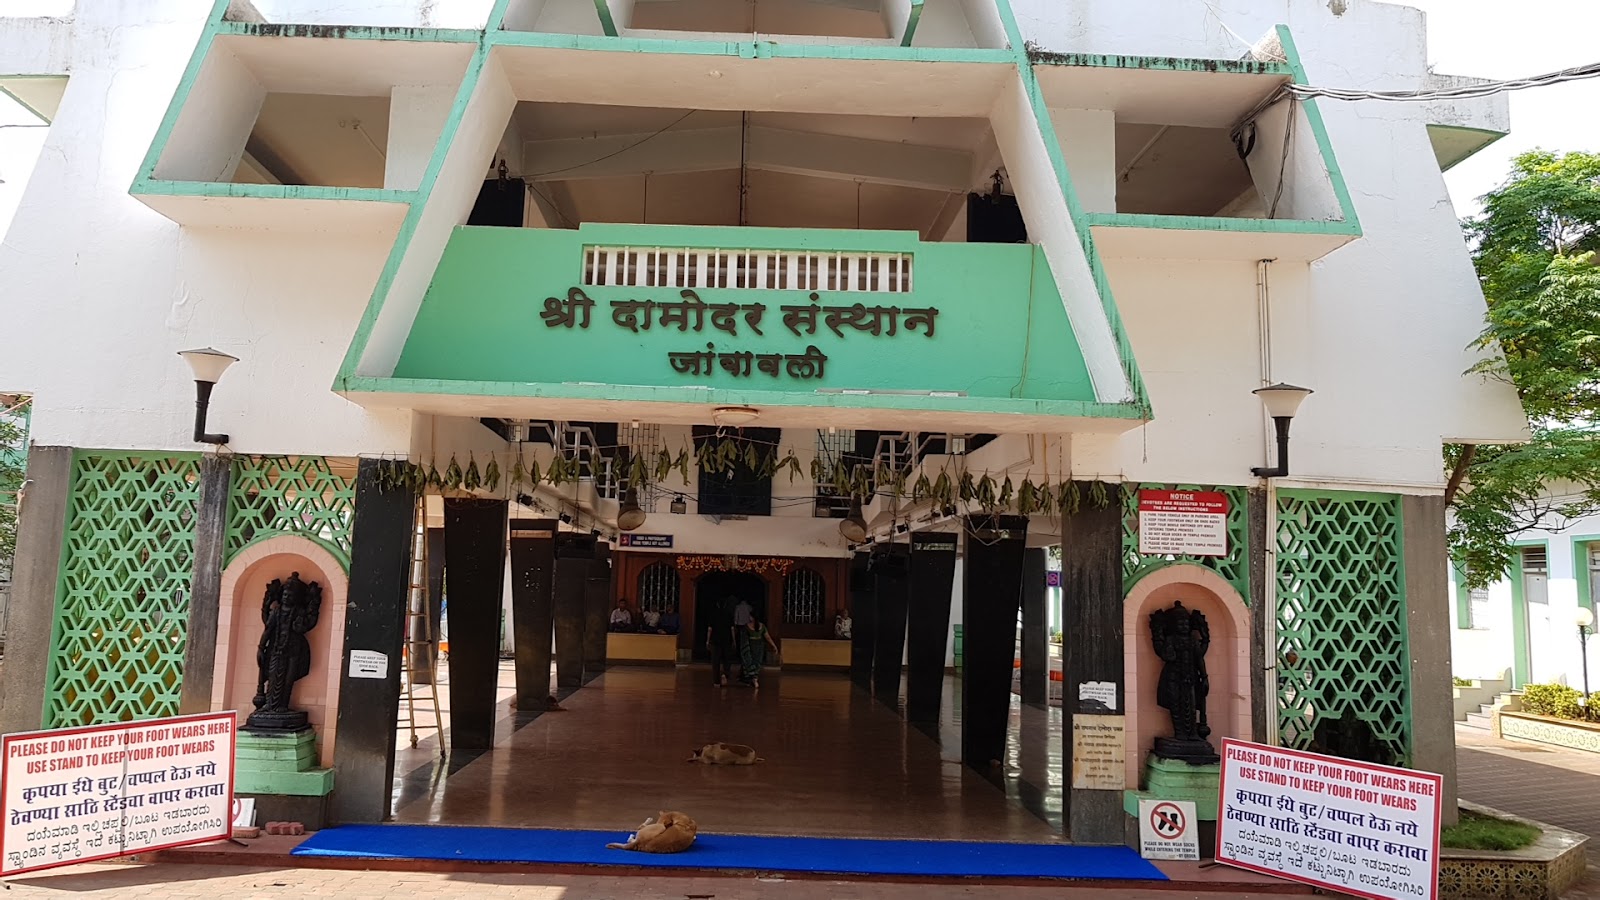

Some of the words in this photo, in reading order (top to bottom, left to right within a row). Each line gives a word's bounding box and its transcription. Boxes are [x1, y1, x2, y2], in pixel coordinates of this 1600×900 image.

[540, 287, 595, 328] श्री
[610, 290, 766, 335] दामोदर
[781, 292, 939, 337] संस्थान
[668, 342, 827, 379] जांबावली
[10, 742, 48, 758] PLEASE
[51, 739, 64, 753] DO
[68, 737, 88, 751] NOT
[91, 734, 114, 748] KEEP
[118, 732, 143, 745] YOUR
[146, 728, 170, 742] FOOT
[172, 724, 205, 739] WEARS
[208, 722, 230, 735] HERE
[27, 761, 47, 774] USE
[50, 756, 83, 772] STAND
[86, 754, 98, 766] TO
[102, 751, 125, 765] KEEP
[128, 747, 153, 761] YOUR
[156, 744, 179, 758] FOOT
[182, 740, 214, 754] WEARS
[22, 782, 68, 804] कृपया
[170, 766, 192, 781] ठेऊ
[195, 761, 217, 777] नये
[1227, 748, 1258, 764] PLEASE
[1259, 754, 1271, 766] DO
[1274, 757, 1291, 770] NOT
[1293, 761, 1315, 774] KEEP
[1318, 765, 1342, 778] YOUR
[1345, 769, 1368, 783] FOOT
[1371, 774, 1406, 792] WEARS
[1409, 781, 1434, 796] HERE
[1240, 767, 1256, 780] USE
[1258, 770, 1286, 786] STAND
[1289, 776, 1300, 788] TO
[1303, 779, 1324, 793] KEEP
[1327, 783, 1352, 798] YOUR
[1355, 788, 1379, 803] FOOT
[1381, 793, 1417, 811] WEARS
[1236, 788, 1272, 807] कृपया
[1369, 813, 1391, 832] ठेऊ
[1396, 820, 1419, 837] नये
